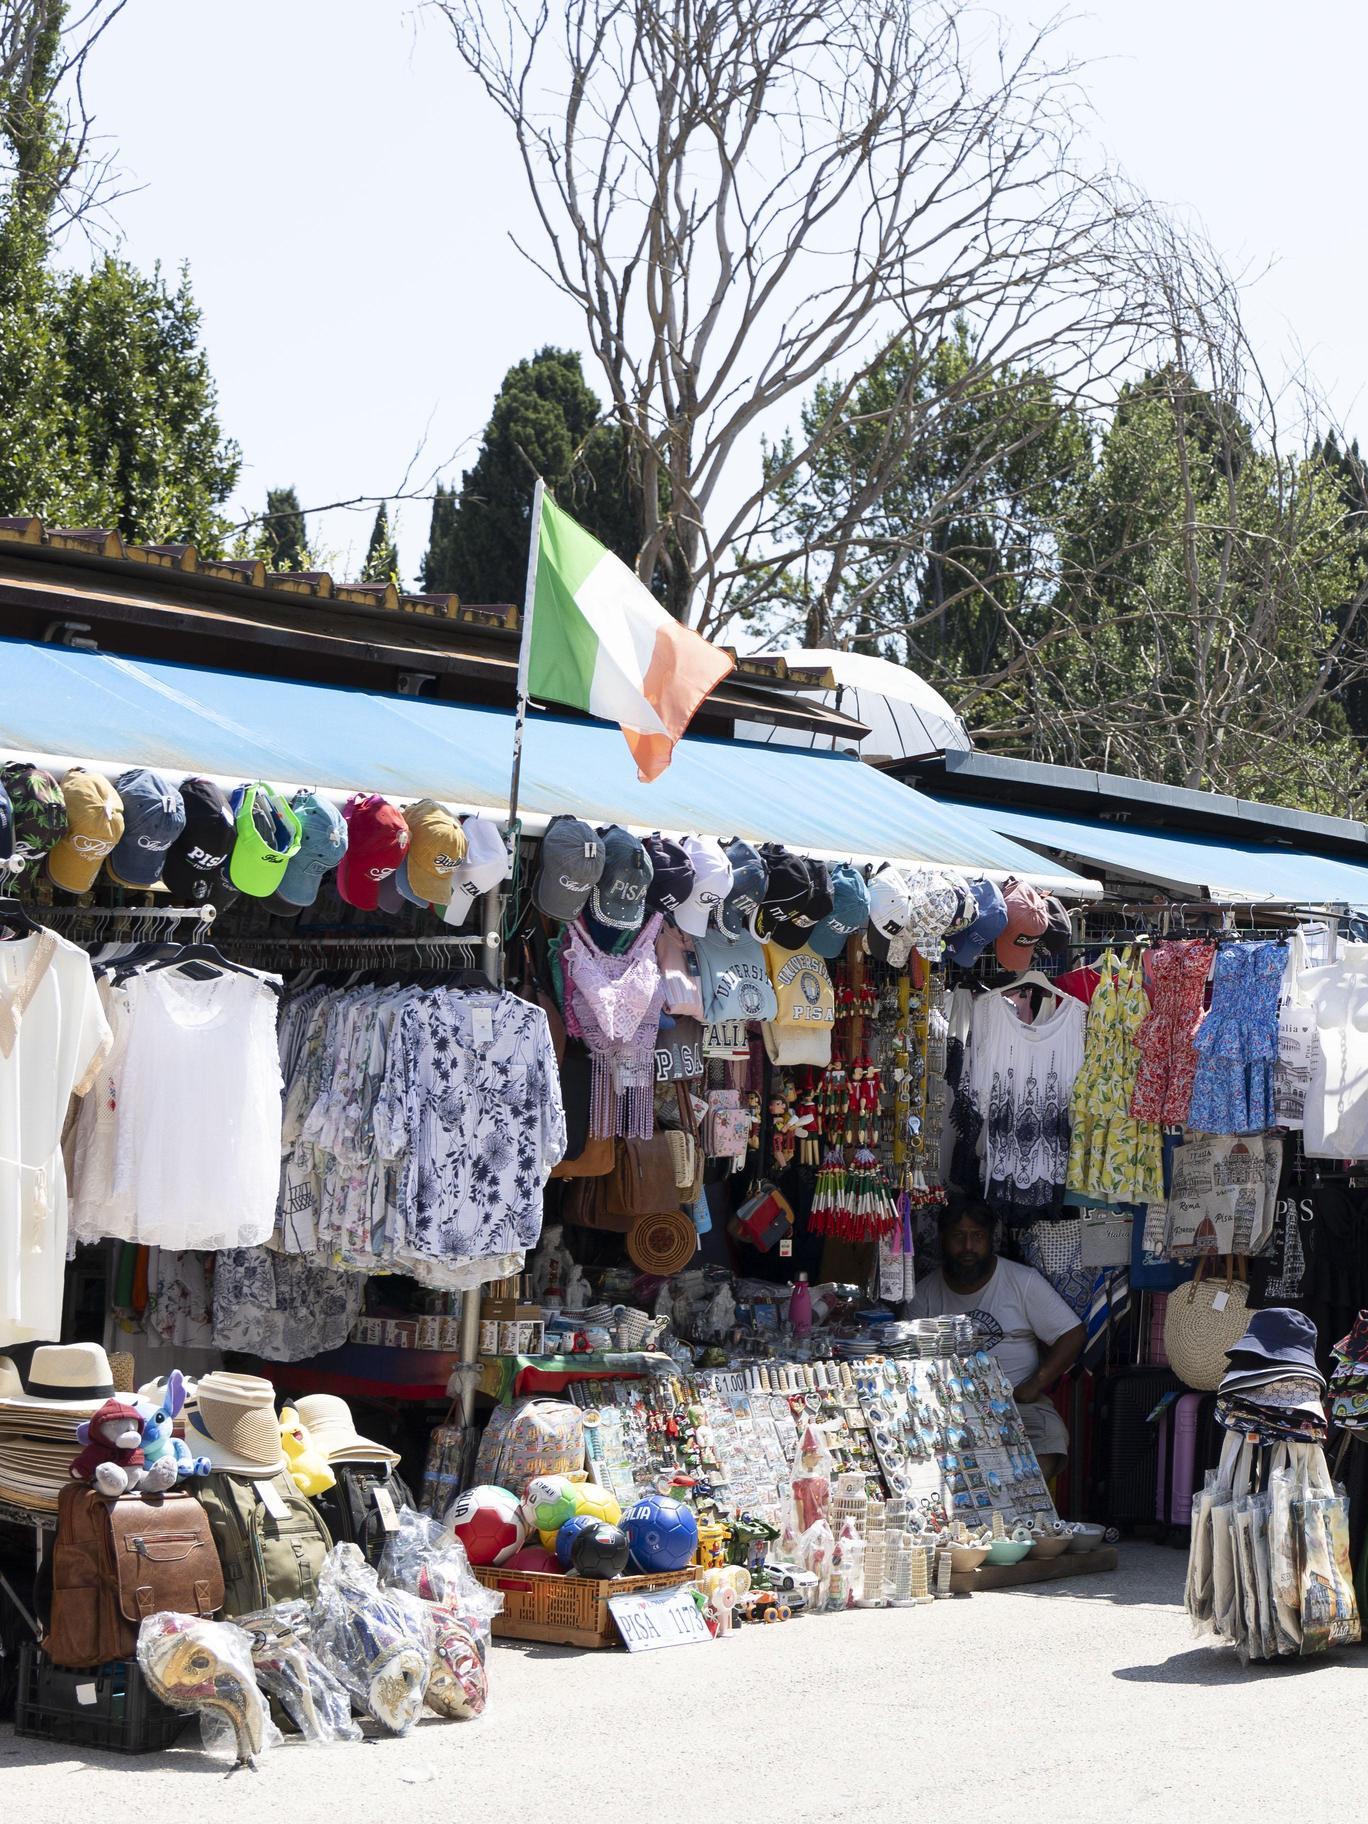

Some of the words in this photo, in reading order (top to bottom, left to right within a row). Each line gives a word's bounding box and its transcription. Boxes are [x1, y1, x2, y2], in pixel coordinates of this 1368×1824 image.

[610, 880, 648, 901] PISA
[793, 1005, 834, 1022] PISA
[619, 1612, 661, 1642] PISA
[668, 1605, 704, 1634] 1173
